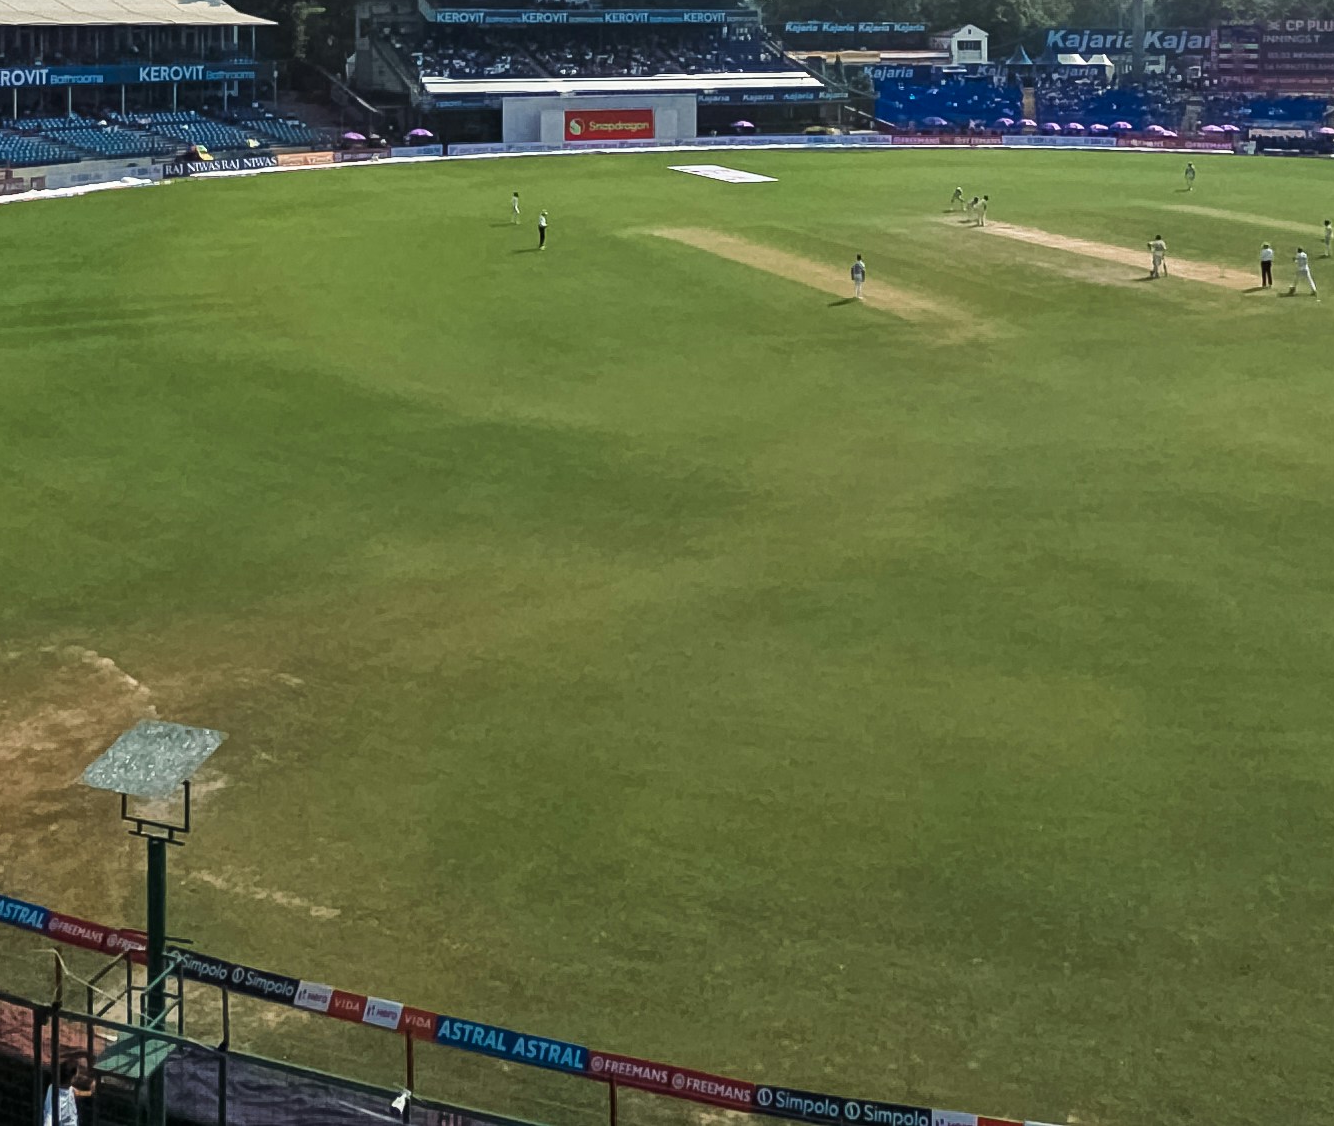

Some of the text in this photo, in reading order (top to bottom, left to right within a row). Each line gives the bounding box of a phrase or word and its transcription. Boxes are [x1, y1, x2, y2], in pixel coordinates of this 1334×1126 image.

[436, 12, 485, 24] KEROVIT
[522, 12, 568, 24] KEROVIT
[605, 13, 650, 23] KEROVIT
[683, 12, 726, 24] KEROVIT
[785, 22, 818, 33] Kajaria
[139, 65, 205, 82] KEROVIT
[863, 66, 914, 79] Kajaria
[588, 120, 650, 133] Snapdragon
[166, 164, 184, 176] RAJ
[187, 160, 220, 173] NIWAS
[221, 160, 241, 171] RAJ
[243, 156, 277, 169] NIWAS
[182, 954, 228, 981] Simpolo
[246, 972, 295, 997] Simpolo
[334, 998, 361, 1013] VIDA
[404, 1013, 431, 1030] VIDA
[437, 1019, 585, 1070] ASTRAL ASTRAL
[604, 1059, 668, 1085] FREEMANS
[686, 1077, 751, 1103] FREEMANS
[775, 1090, 839, 1118] Simpolo
[864, 1104, 929, 1126] Simpolo
